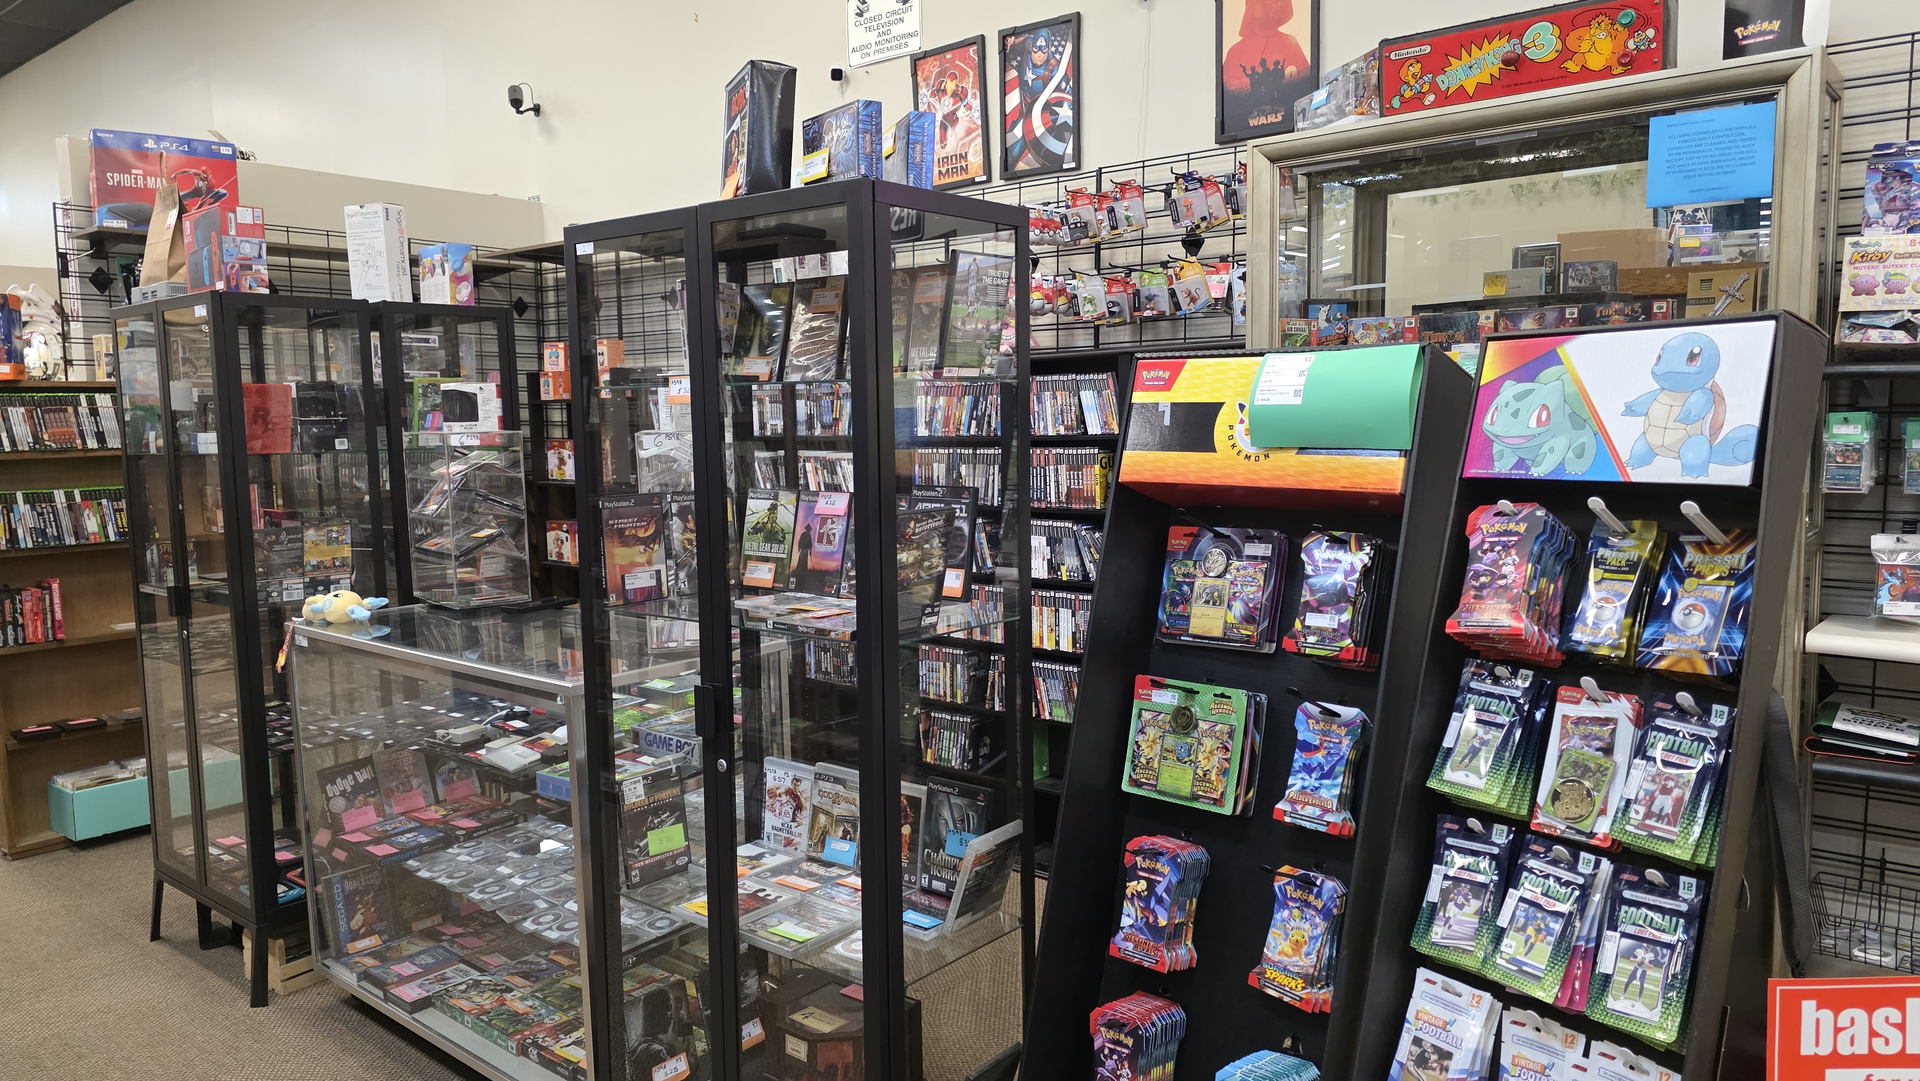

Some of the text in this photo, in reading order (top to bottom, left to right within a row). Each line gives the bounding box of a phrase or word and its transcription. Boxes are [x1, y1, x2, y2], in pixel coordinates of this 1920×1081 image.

[854, 5, 913, 27] CLOSED CIRCUIT
[864, 17, 904, 33] TELEVISION
[877, 29, 891, 38] AND
[851, 30, 918, 54] AUDIO MONITORING
[873, 42, 908, 56] PREMISES
[1393, 47, 1427, 58] Nintendo
[1435, 53, 1484, 91] DONKEY
[1522, 21, 1562, 63] 3
[1248, 113, 1284, 127] WARS
[1692, 129, 1718, 137] CONSOLES
[160, 142, 189, 151] PS4
[936, 151, 969, 181] IRON MAN
[1672, 167, 1697, 175] PURCHASE
[398, 236, 408, 276] Dreamcast
[1850, 250, 1892, 264] Kirby
[987, 269, 1001, 277] TRUE
[992, 278, 1009, 286] GAME
[1632, 303, 1642, 316] 3
[910, 347, 929, 358] METAL
[745, 541, 758, 551] METAL
[759, 543, 772, 552] GEAR
[772, 544, 785, 553] SOLID
[1596, 547, 1639, 562] PRESSTI
[1606, 557, 1626, 566] PACK
[1683, 552, 1748, 569] PRESSTI
[1693, 564, 1730, 577] PICKS
[1462, 693, 1516, 720] FOOTBALL
[1714, 709, 1725, 719] 12
[645, 732, 696, 758] GAME BOY
[380, 750, 417, 763] BLADES
[1675, 756, 1690, 764] PACK
[326, 764, 374, 798] dodge ball
[654, 788, 681, 801] FORTUNE
[1289, 791, 1332, 809] PALDEA EVOLVED
[473, 829, 488, 837] NATIONAL
[771, 824, 797, 837] BASKETBALL
[1495, 828, 1505, 837] 12
[381, 850, 419, 866] GYROMITE
[1582, 856, 1592, 867] 12
[1517, 871, 1577, 911] FOOTBALL
[1682, 881, 1694, 892] 12
[334, 884, 348, 932] SEGA CD
[1544, 899, 1557, 907] PACK
[1617, 905, 1685, 935] FOOTBALL
[1262, 961, 1299, 980] SURGING
[1265, 969, 1305, 991] SPARKS
[1471, 993, 1483, 1005] 12
[1418, 1011, 1444, 1027] VINTAGE
[1416, 1020, 1465, 1051] FOOTBALL
[1564, 1032, 1576, 1047] 12
[1514, 1057, 1542, 1072] VINTAGE
[1659, 1071, 1671, 1081] 12
